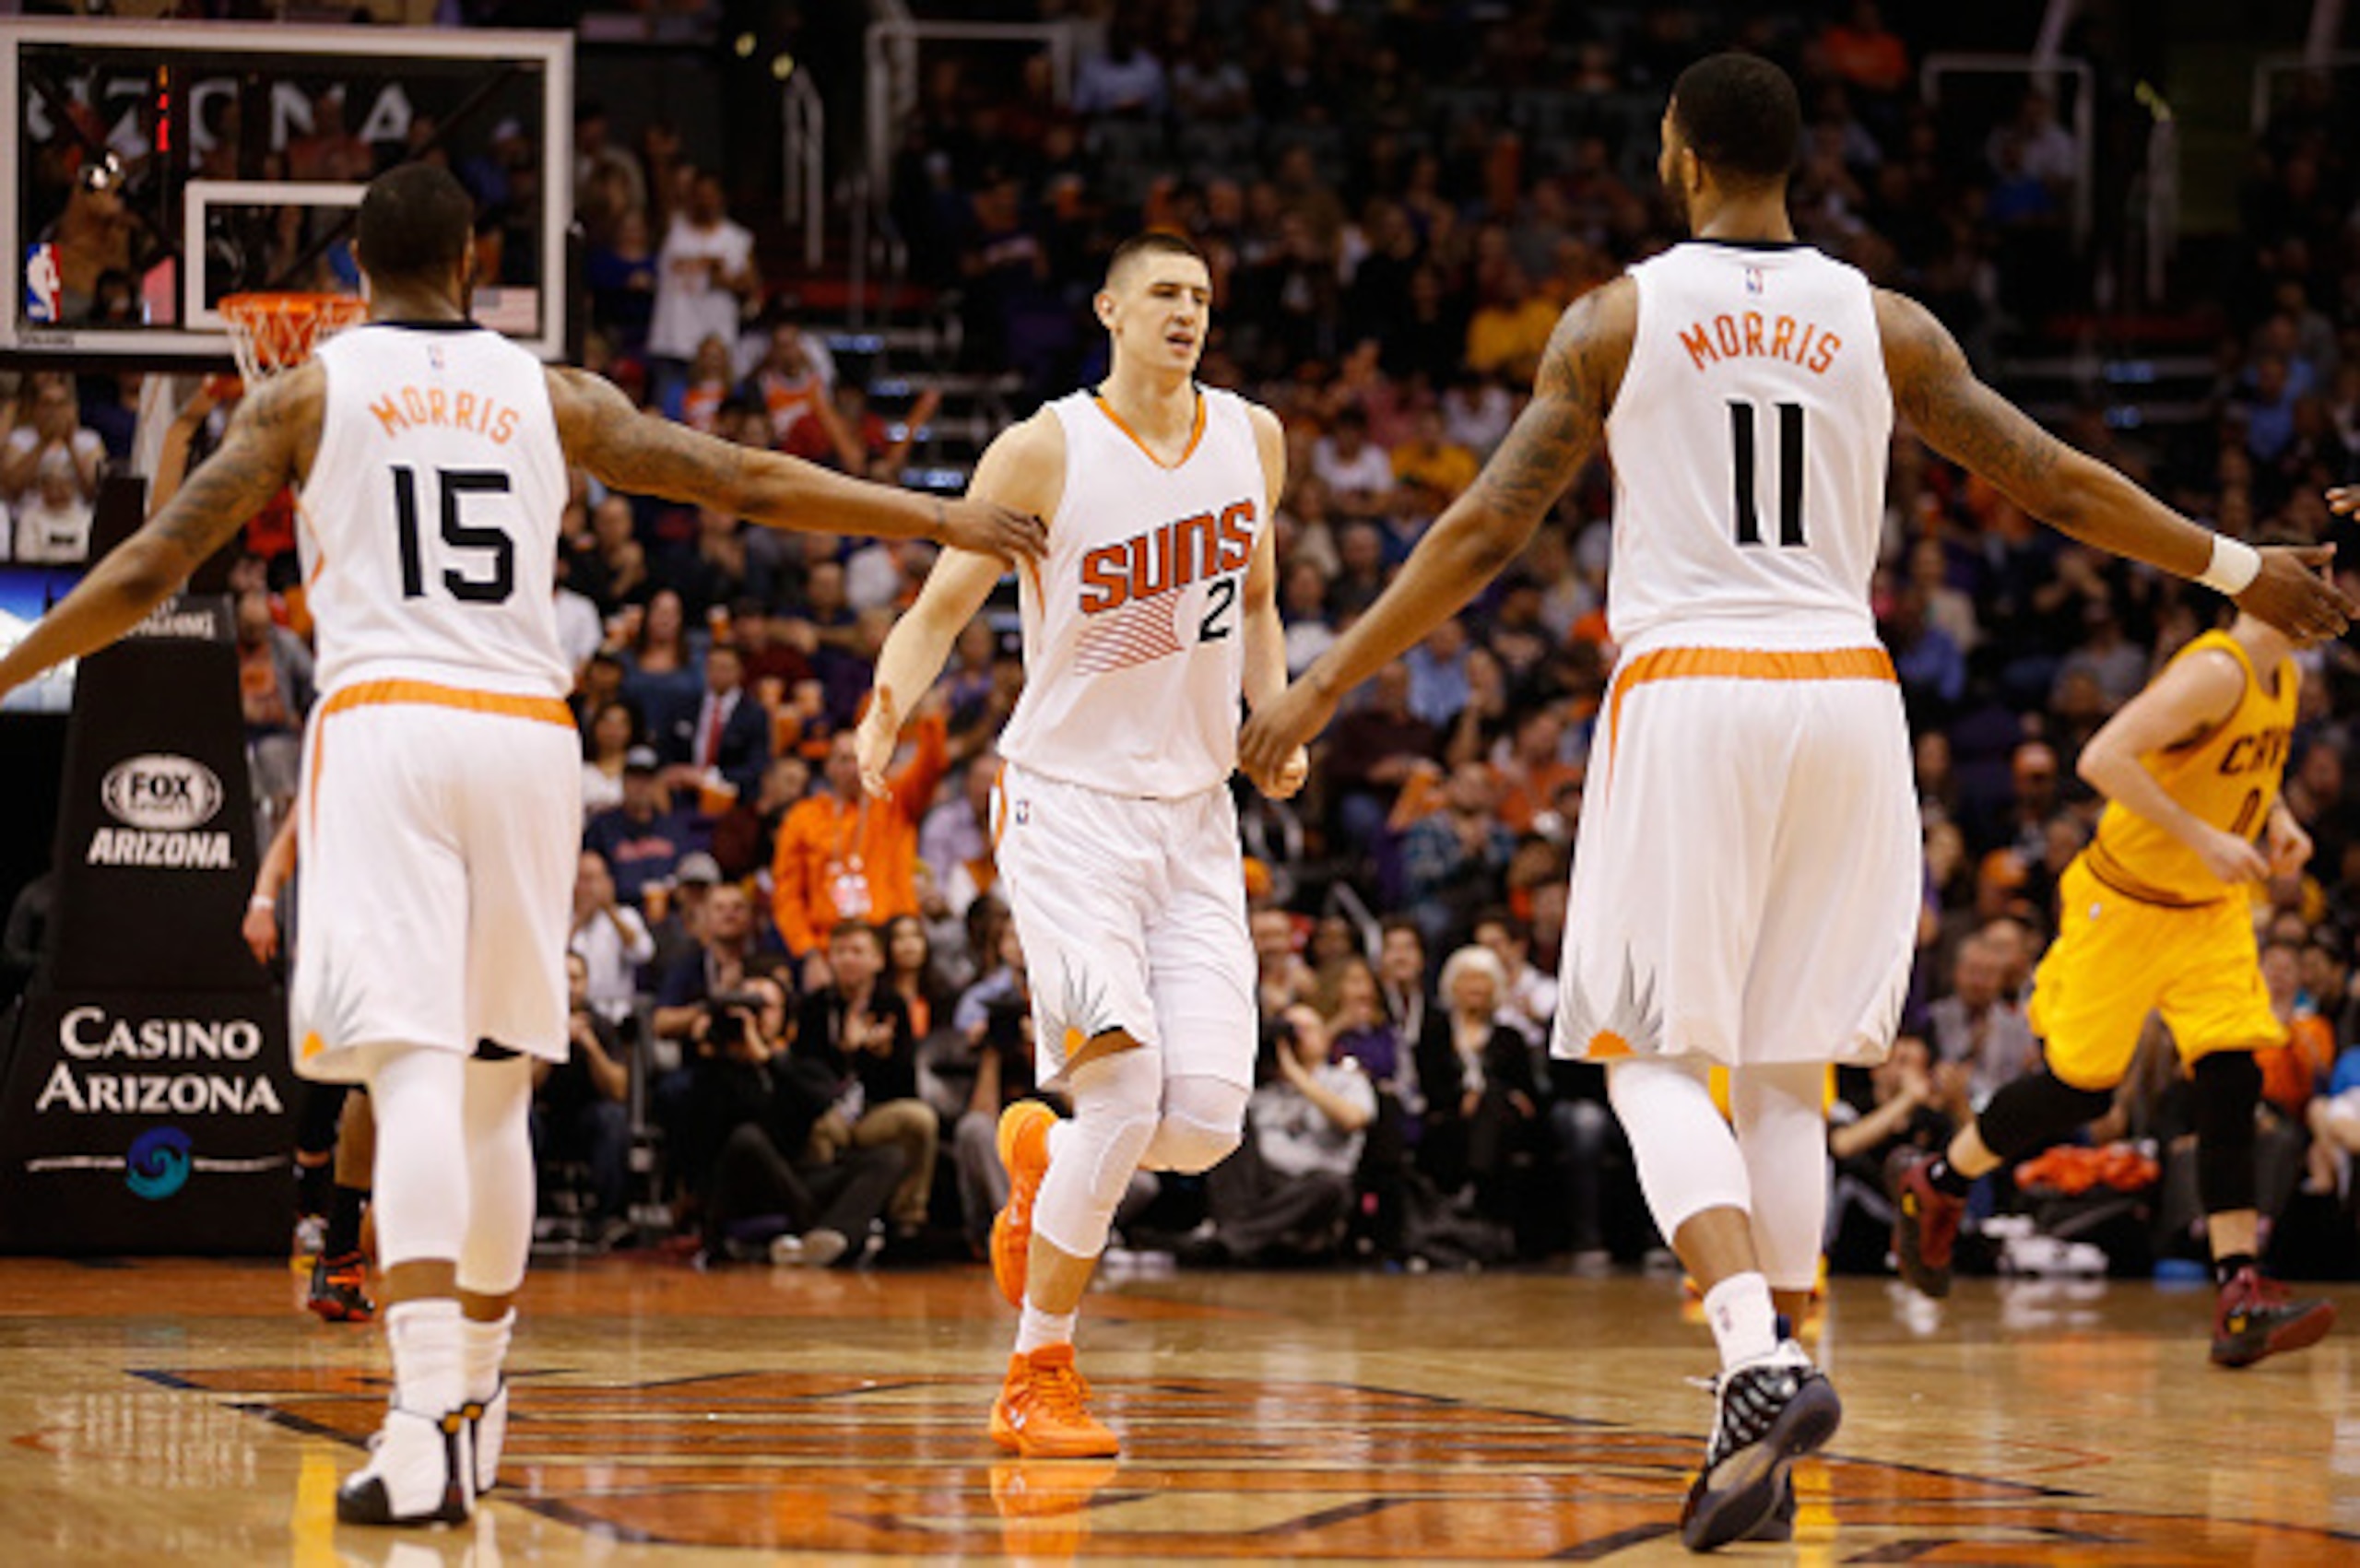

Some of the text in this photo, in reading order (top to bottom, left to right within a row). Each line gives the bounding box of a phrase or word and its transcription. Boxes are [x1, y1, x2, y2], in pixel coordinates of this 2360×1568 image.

[1678, 311, 1842, 374] MORRIS
[369, 385, 520, 445] MORRIS
[1726, 400, 1809, 548] 11
[392, 466, 515, 604] 15
[1079, 498, 1255, 615] SUNS
[1199, 577, 1235, 643] 2
[130, 771, 193, 802] FOX
[87, 827, 231, 868] ARIZONA
[59, 1006, 262, 1061] CASINO
[35, 1062, 283, 1114] ARIZONA
